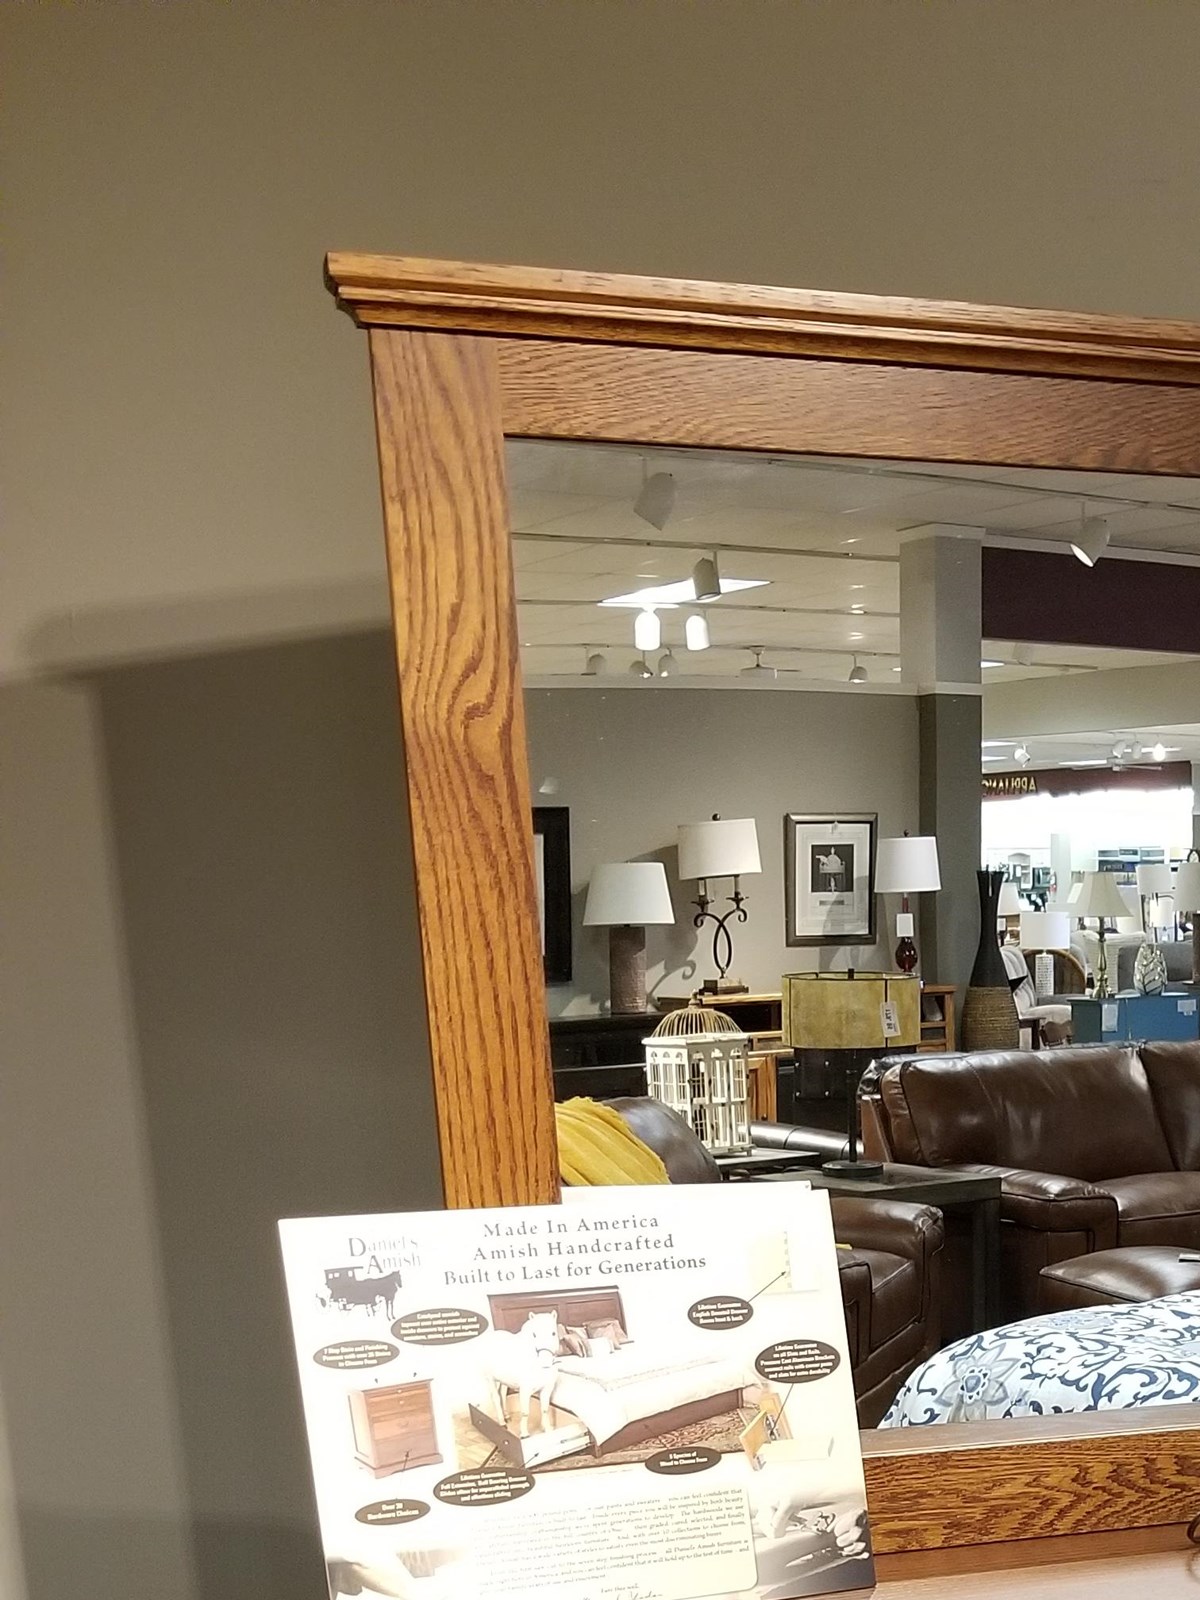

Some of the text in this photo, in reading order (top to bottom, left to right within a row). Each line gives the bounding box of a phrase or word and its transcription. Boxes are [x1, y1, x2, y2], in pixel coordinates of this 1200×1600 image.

[484, 1215, 658, 1237] Made In America
[474, 1234, 674, 1261] Amish Handcrafted
[444, 1255, 706, 1285] Built to Last for Generations
